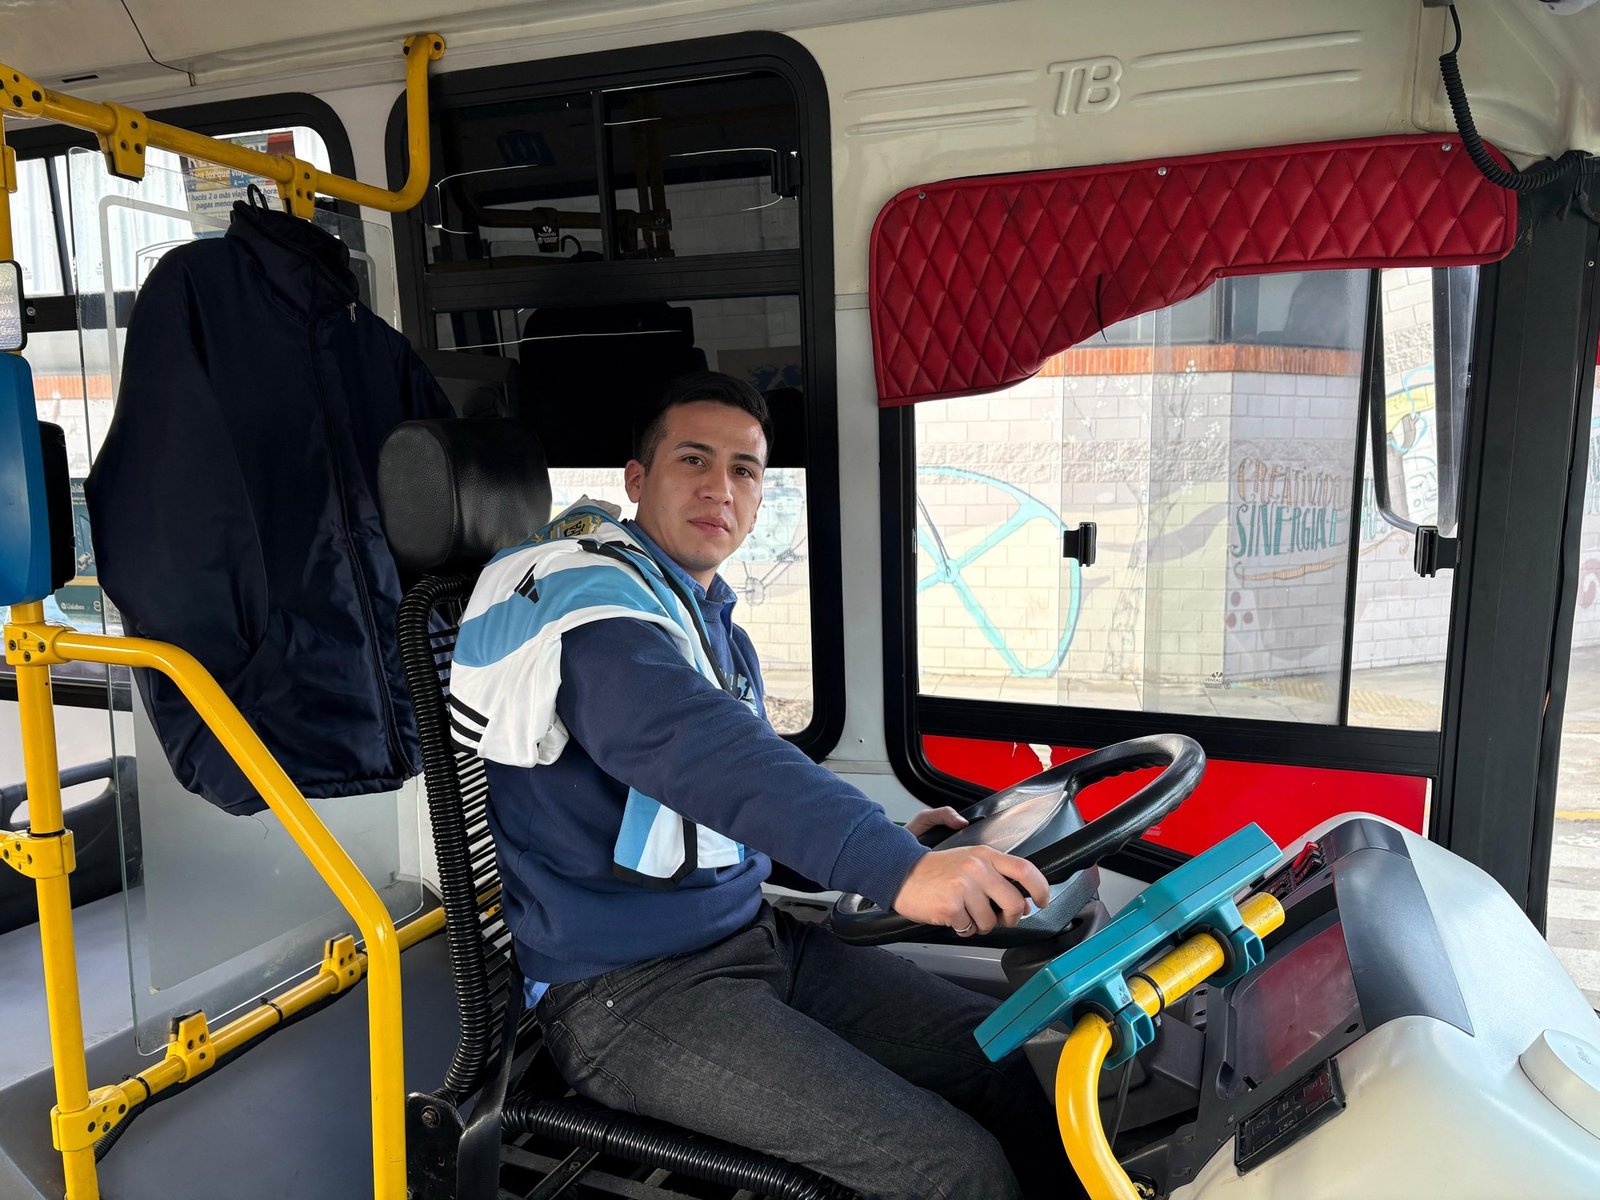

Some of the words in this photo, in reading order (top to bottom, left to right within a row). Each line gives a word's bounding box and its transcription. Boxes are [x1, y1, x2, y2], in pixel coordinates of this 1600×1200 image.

[1047, 54, 1122, 117] TB
[217, 170, 230, 180] que
[219, 191, 231, 199] más
[232, 188, 248, 198] viaje
